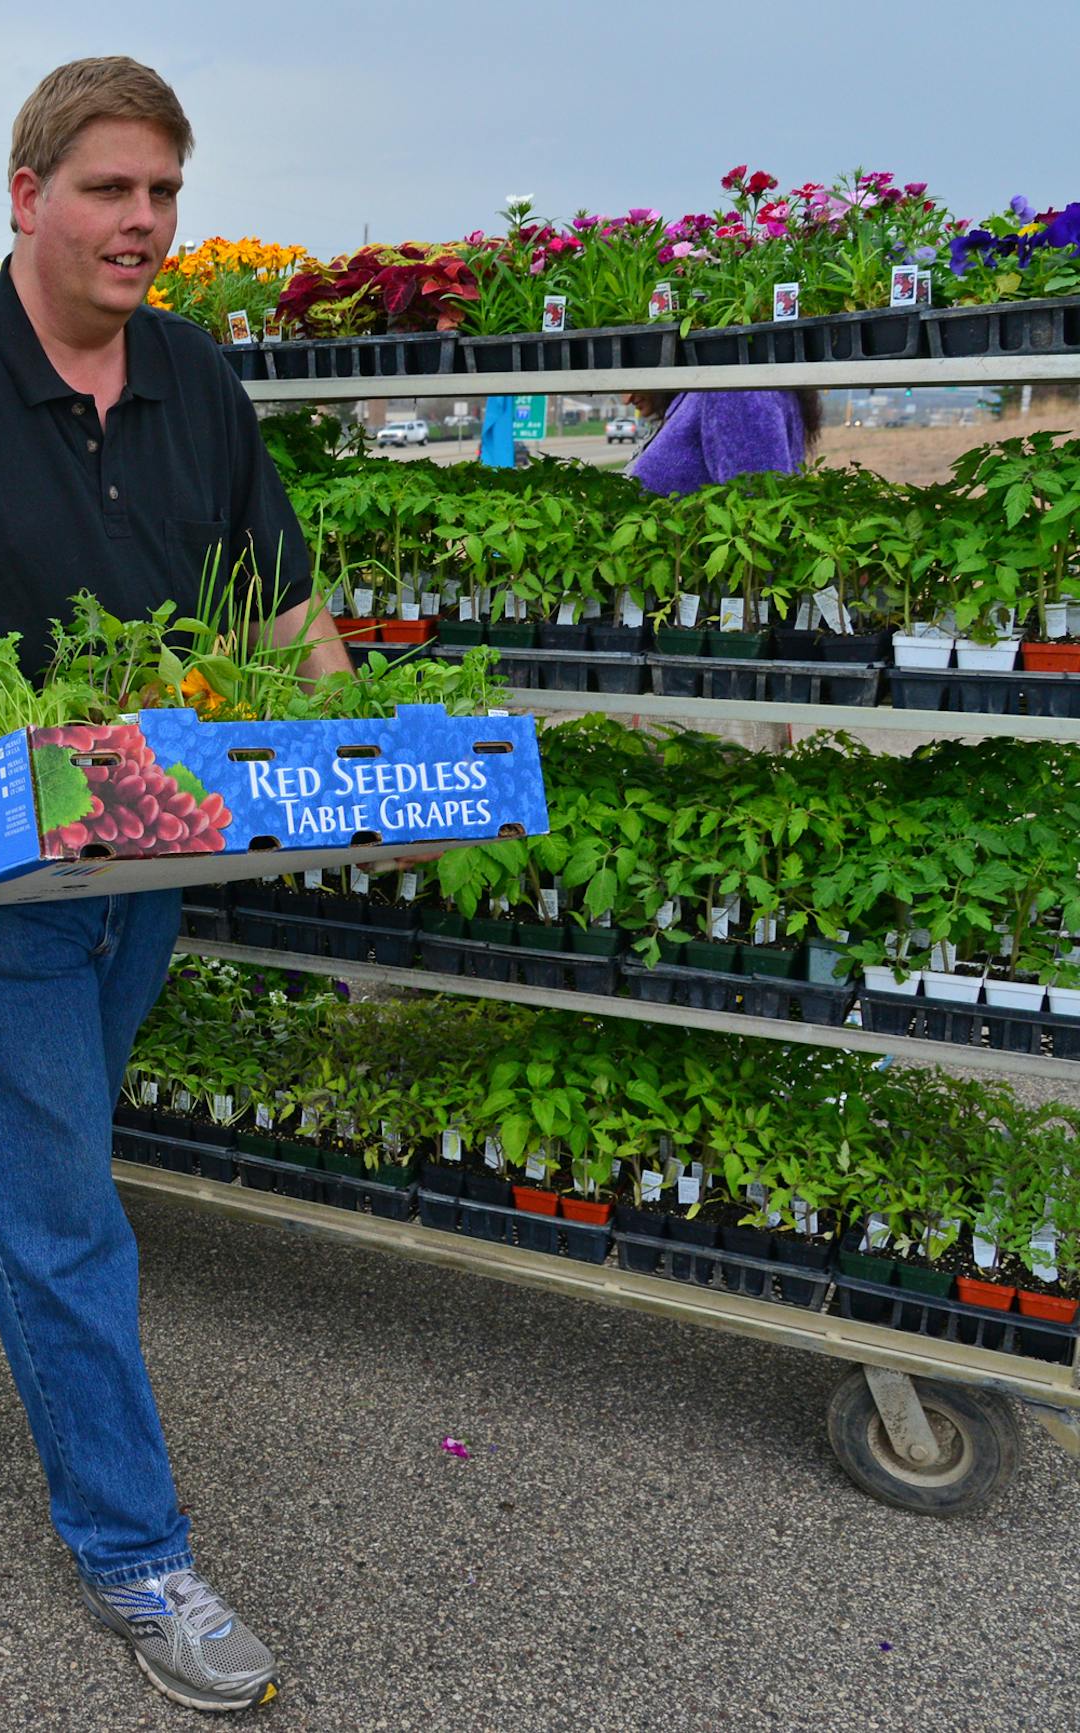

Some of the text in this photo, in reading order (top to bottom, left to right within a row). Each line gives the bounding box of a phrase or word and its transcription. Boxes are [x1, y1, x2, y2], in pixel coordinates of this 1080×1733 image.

[248, 757, 487, 800] RED SEEDLESS
[278, 794, 492, 835] TABLE GRAPES
